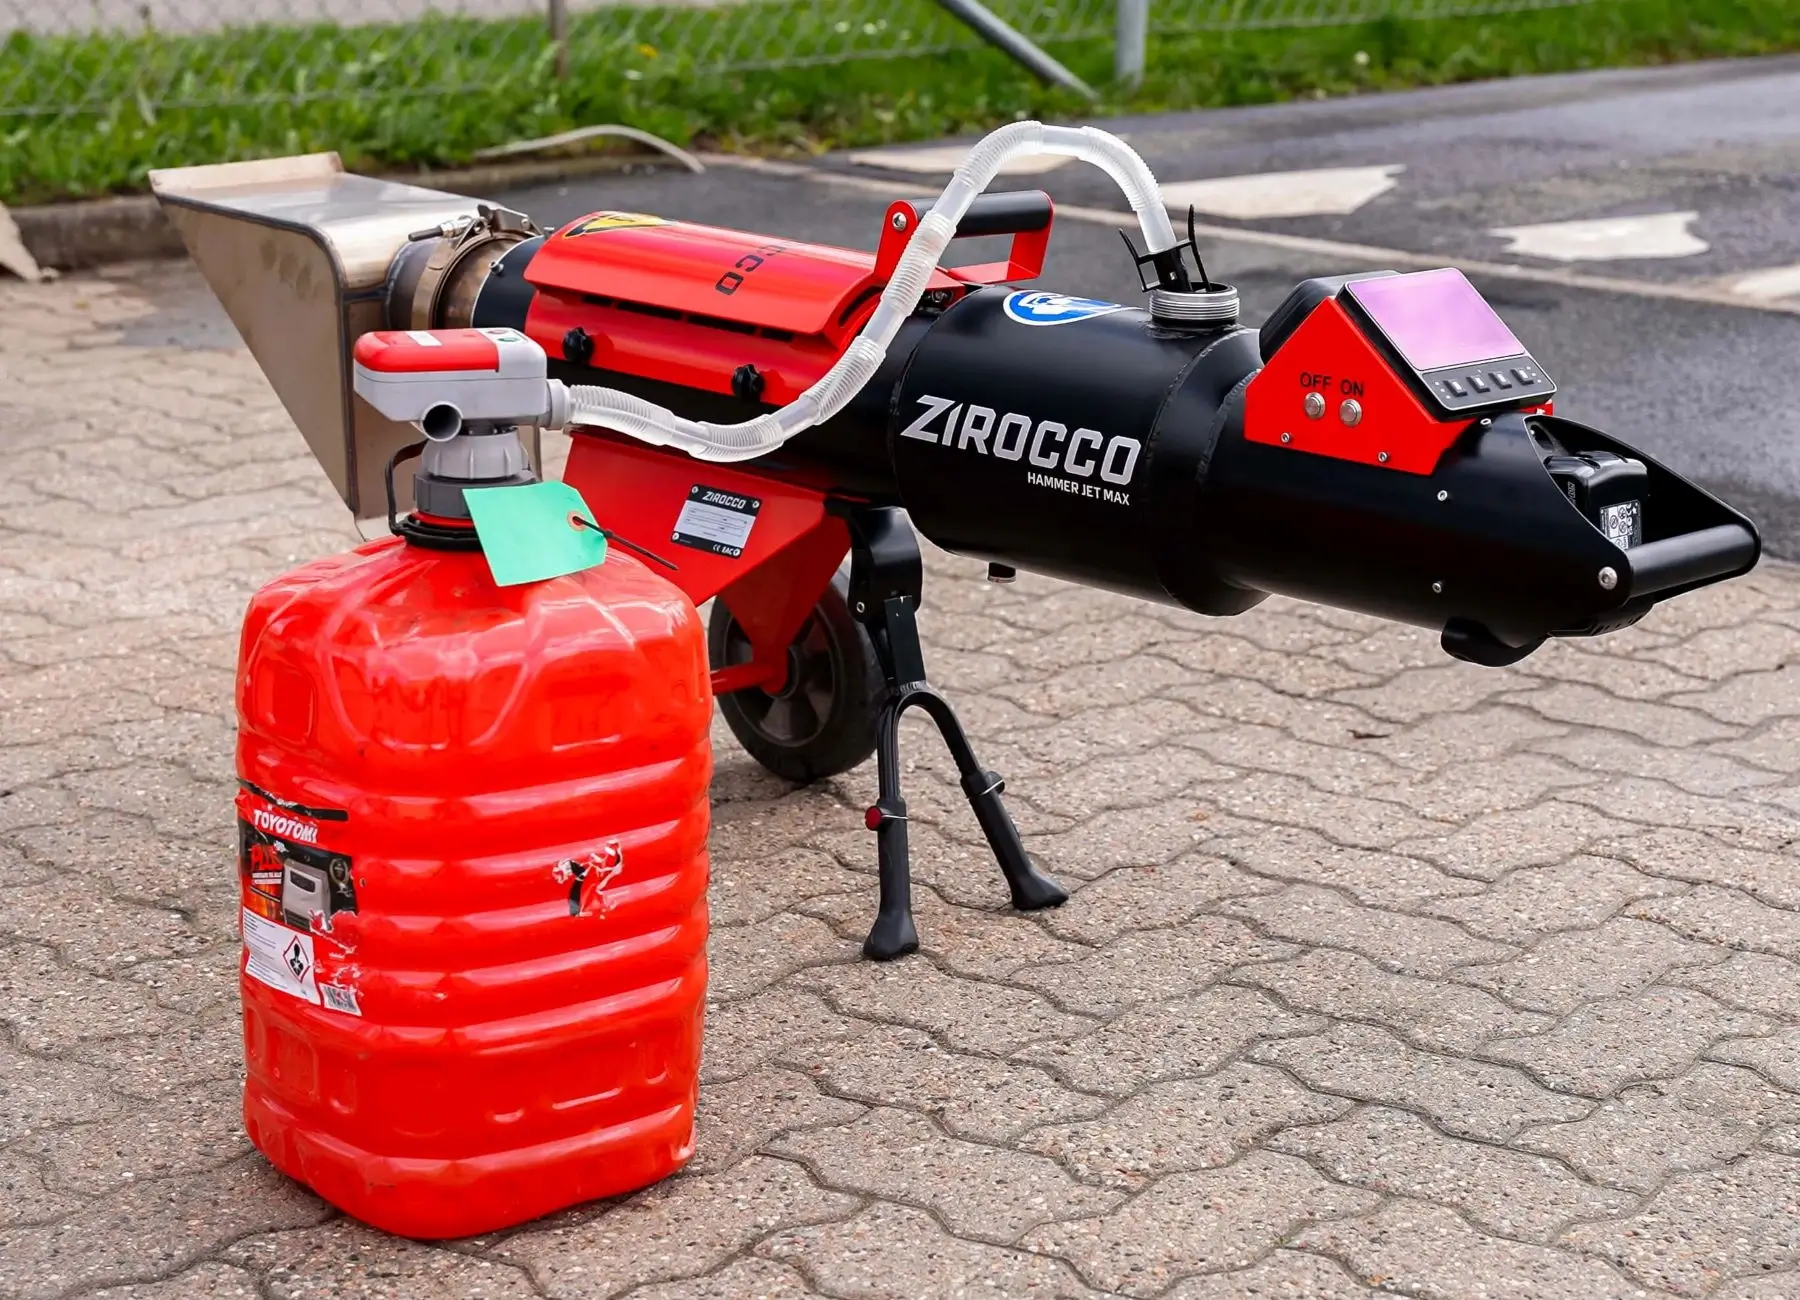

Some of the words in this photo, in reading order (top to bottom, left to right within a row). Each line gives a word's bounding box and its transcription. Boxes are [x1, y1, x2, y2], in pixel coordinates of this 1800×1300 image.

[1300, 372, 1332, 391] OFF
[1340, 379, 1364, 397] ON
[900, 394, 1142, 486] ZIROCCO
[702, 491, 747, 509] ZIROCCO
[1027, 471, 1079, 494] HAMMER
[1081, 483, 1101, 499] JET
[1103, 488, 1130, 506] MAX
